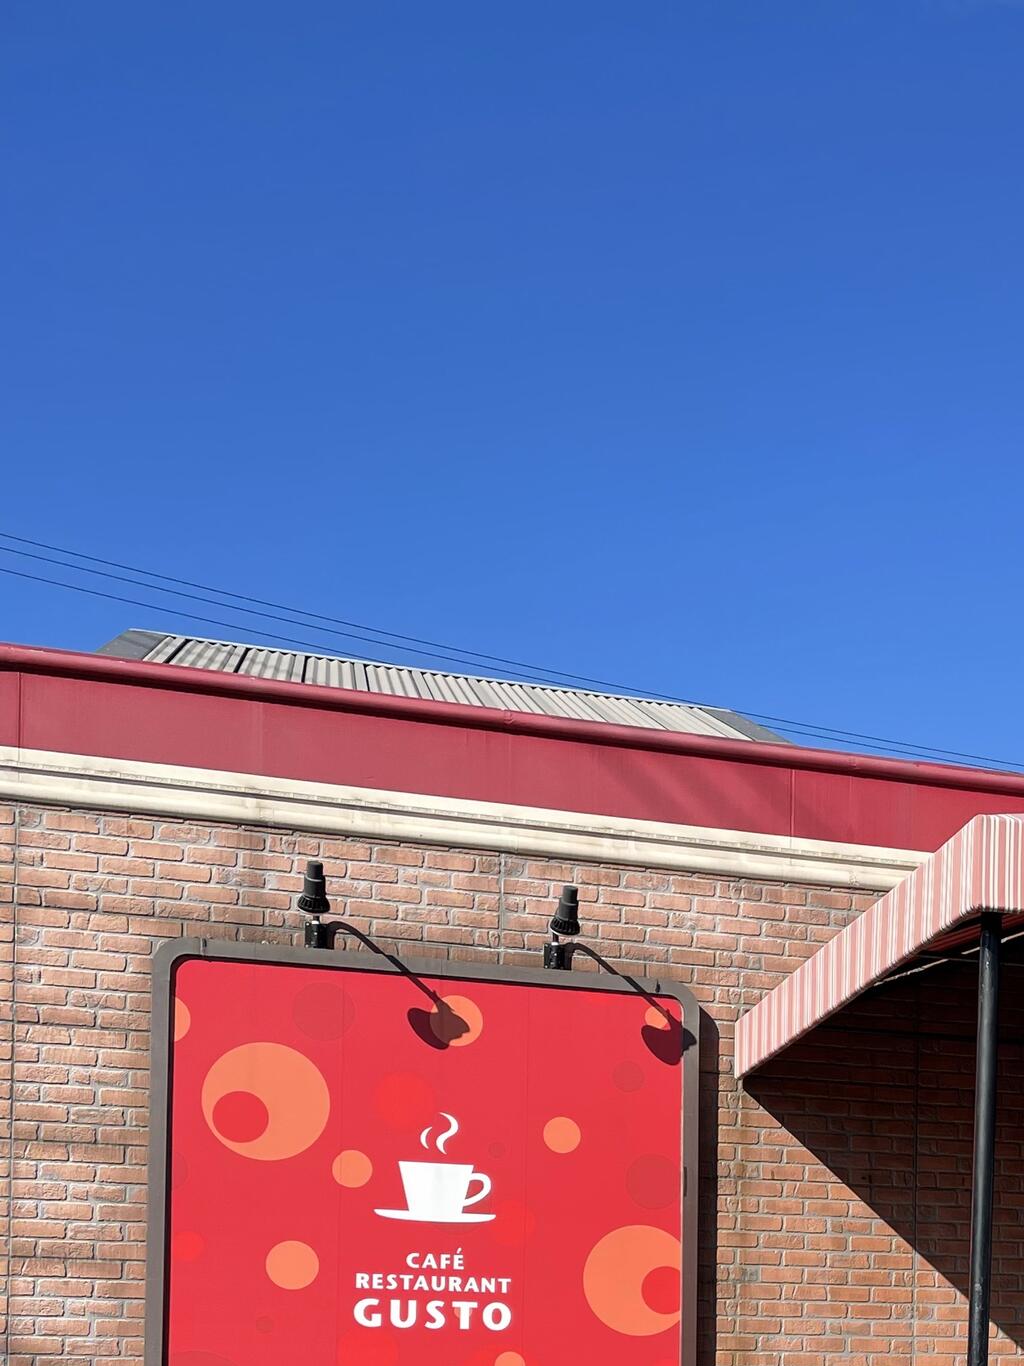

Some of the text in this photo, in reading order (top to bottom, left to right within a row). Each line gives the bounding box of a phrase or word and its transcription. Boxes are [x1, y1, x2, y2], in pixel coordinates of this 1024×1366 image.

[406, 1247, 464, 1270] CAFÉ
[355, 1273, 512, 1294] RESTAURANT
[353, 1298, 512, 1331] GUSTO
